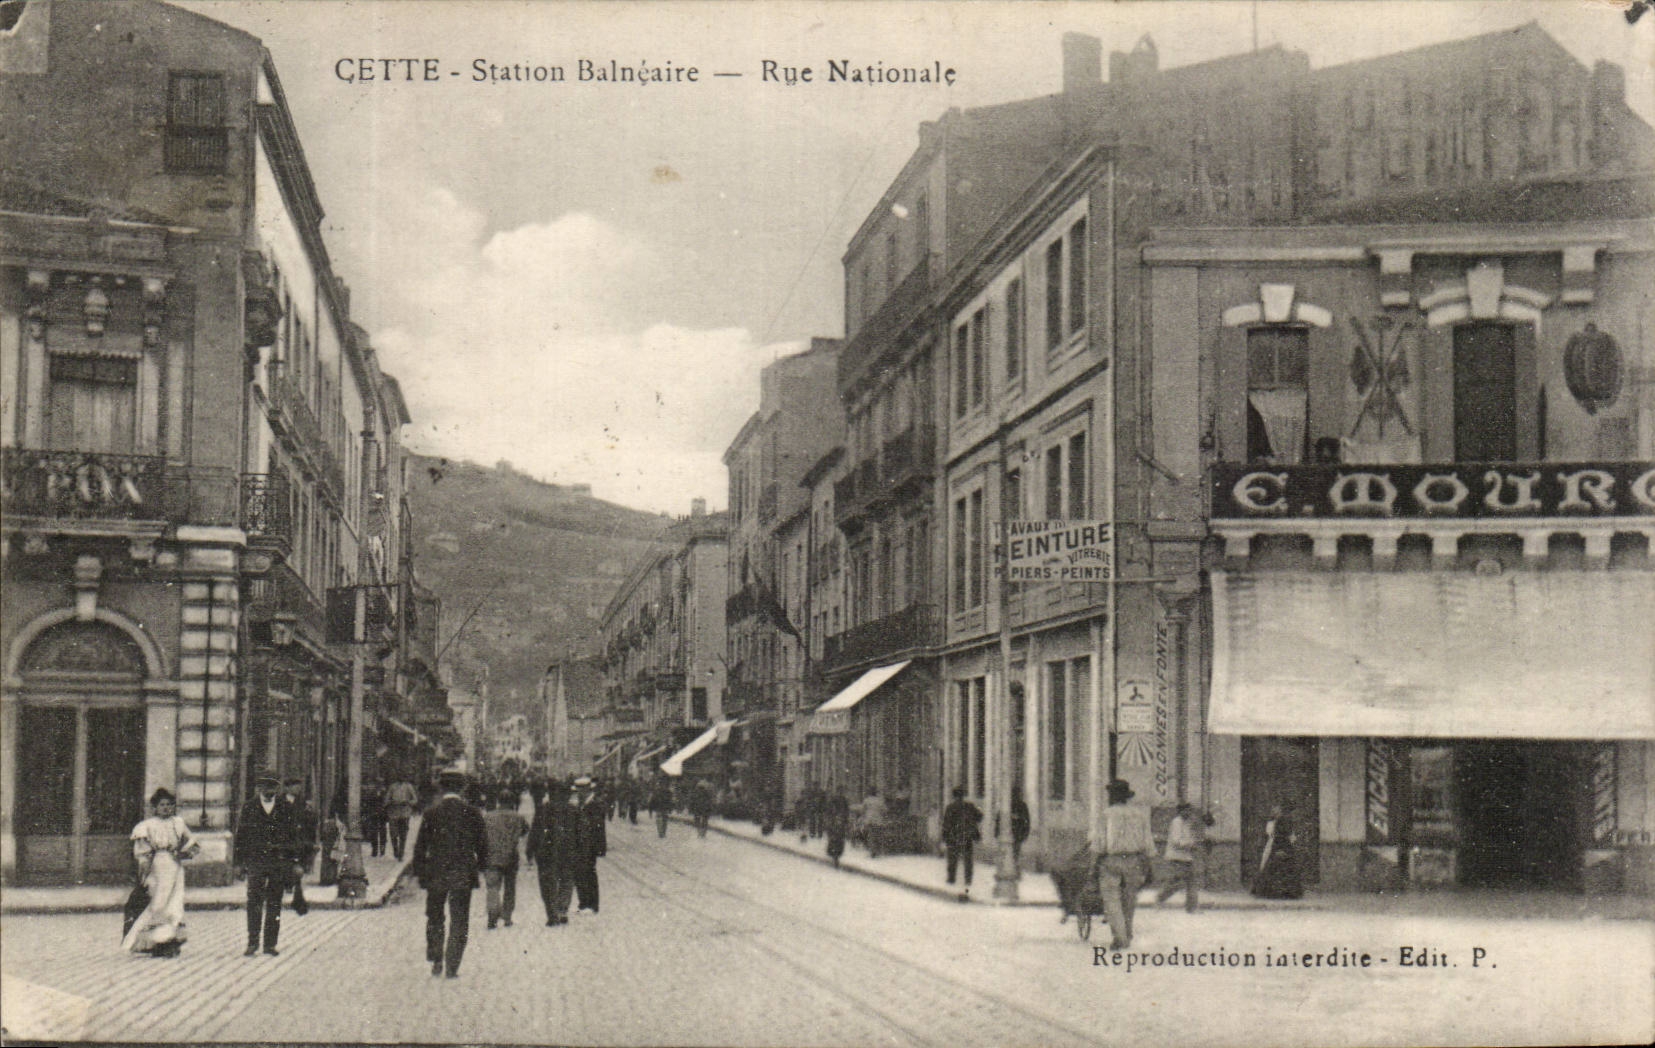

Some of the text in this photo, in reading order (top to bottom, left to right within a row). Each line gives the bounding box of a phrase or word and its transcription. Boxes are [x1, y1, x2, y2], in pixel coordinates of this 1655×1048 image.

[1232, 470, 1315, 514] E.
[993, 521, 1049, 539] TAVAUX
[1156, 621, 1168, 683] FONTE
[1156, 706, 1167, 797] COLONNES
